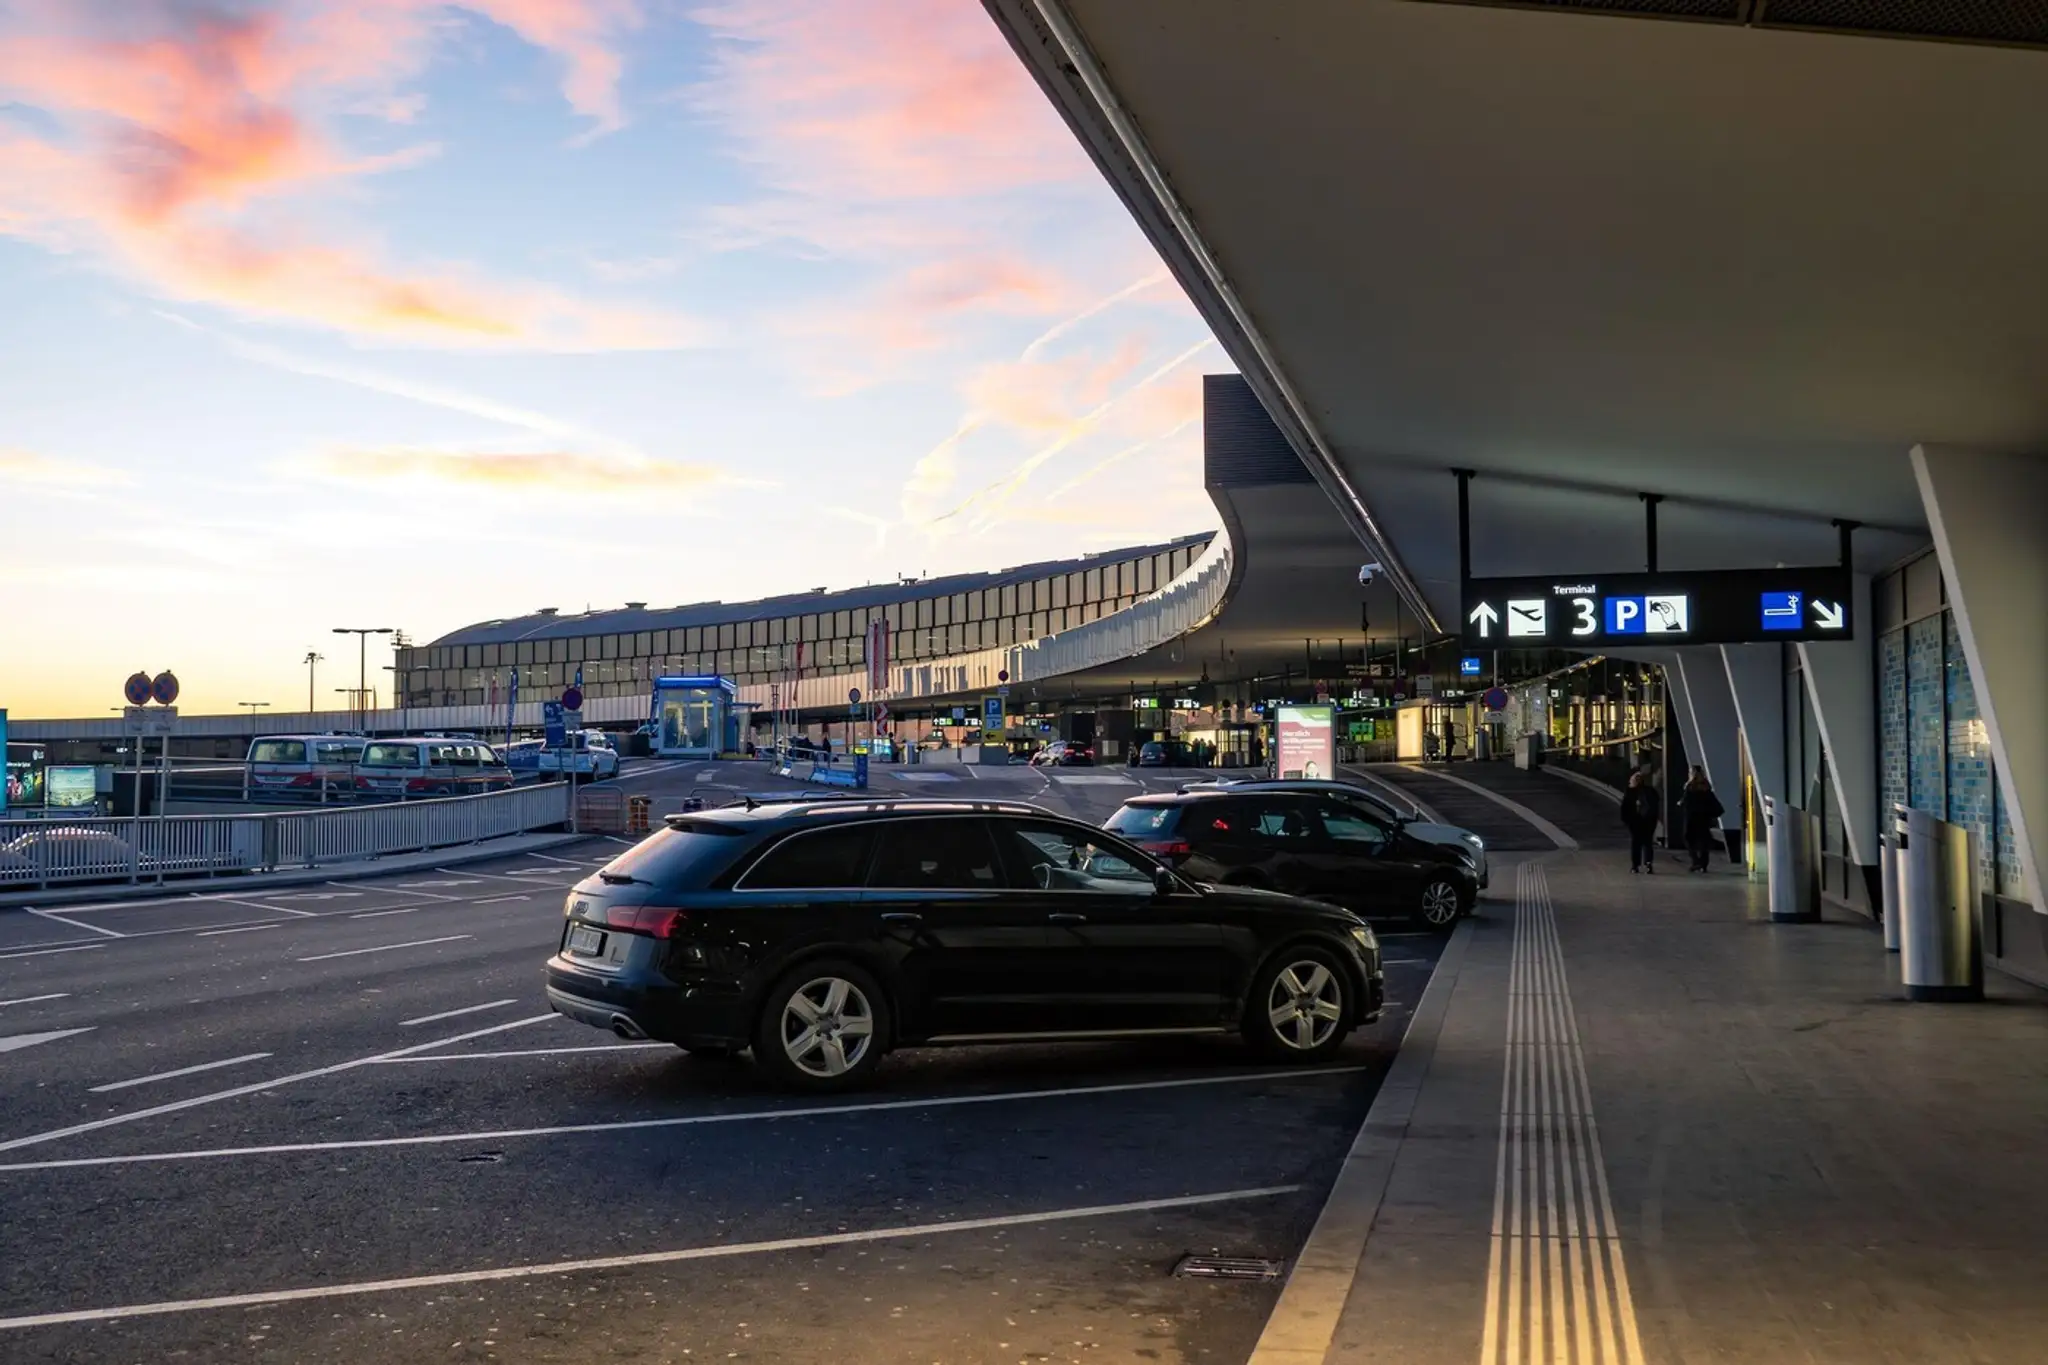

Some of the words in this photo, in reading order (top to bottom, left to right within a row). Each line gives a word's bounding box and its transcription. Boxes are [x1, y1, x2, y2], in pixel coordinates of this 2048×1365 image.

[1553, 585, 1596, 594] Terminal
[1572, 598, 1597, 635] 3
[1616, 600, 1638, 630] P
[988, 699, 999, 714] P
